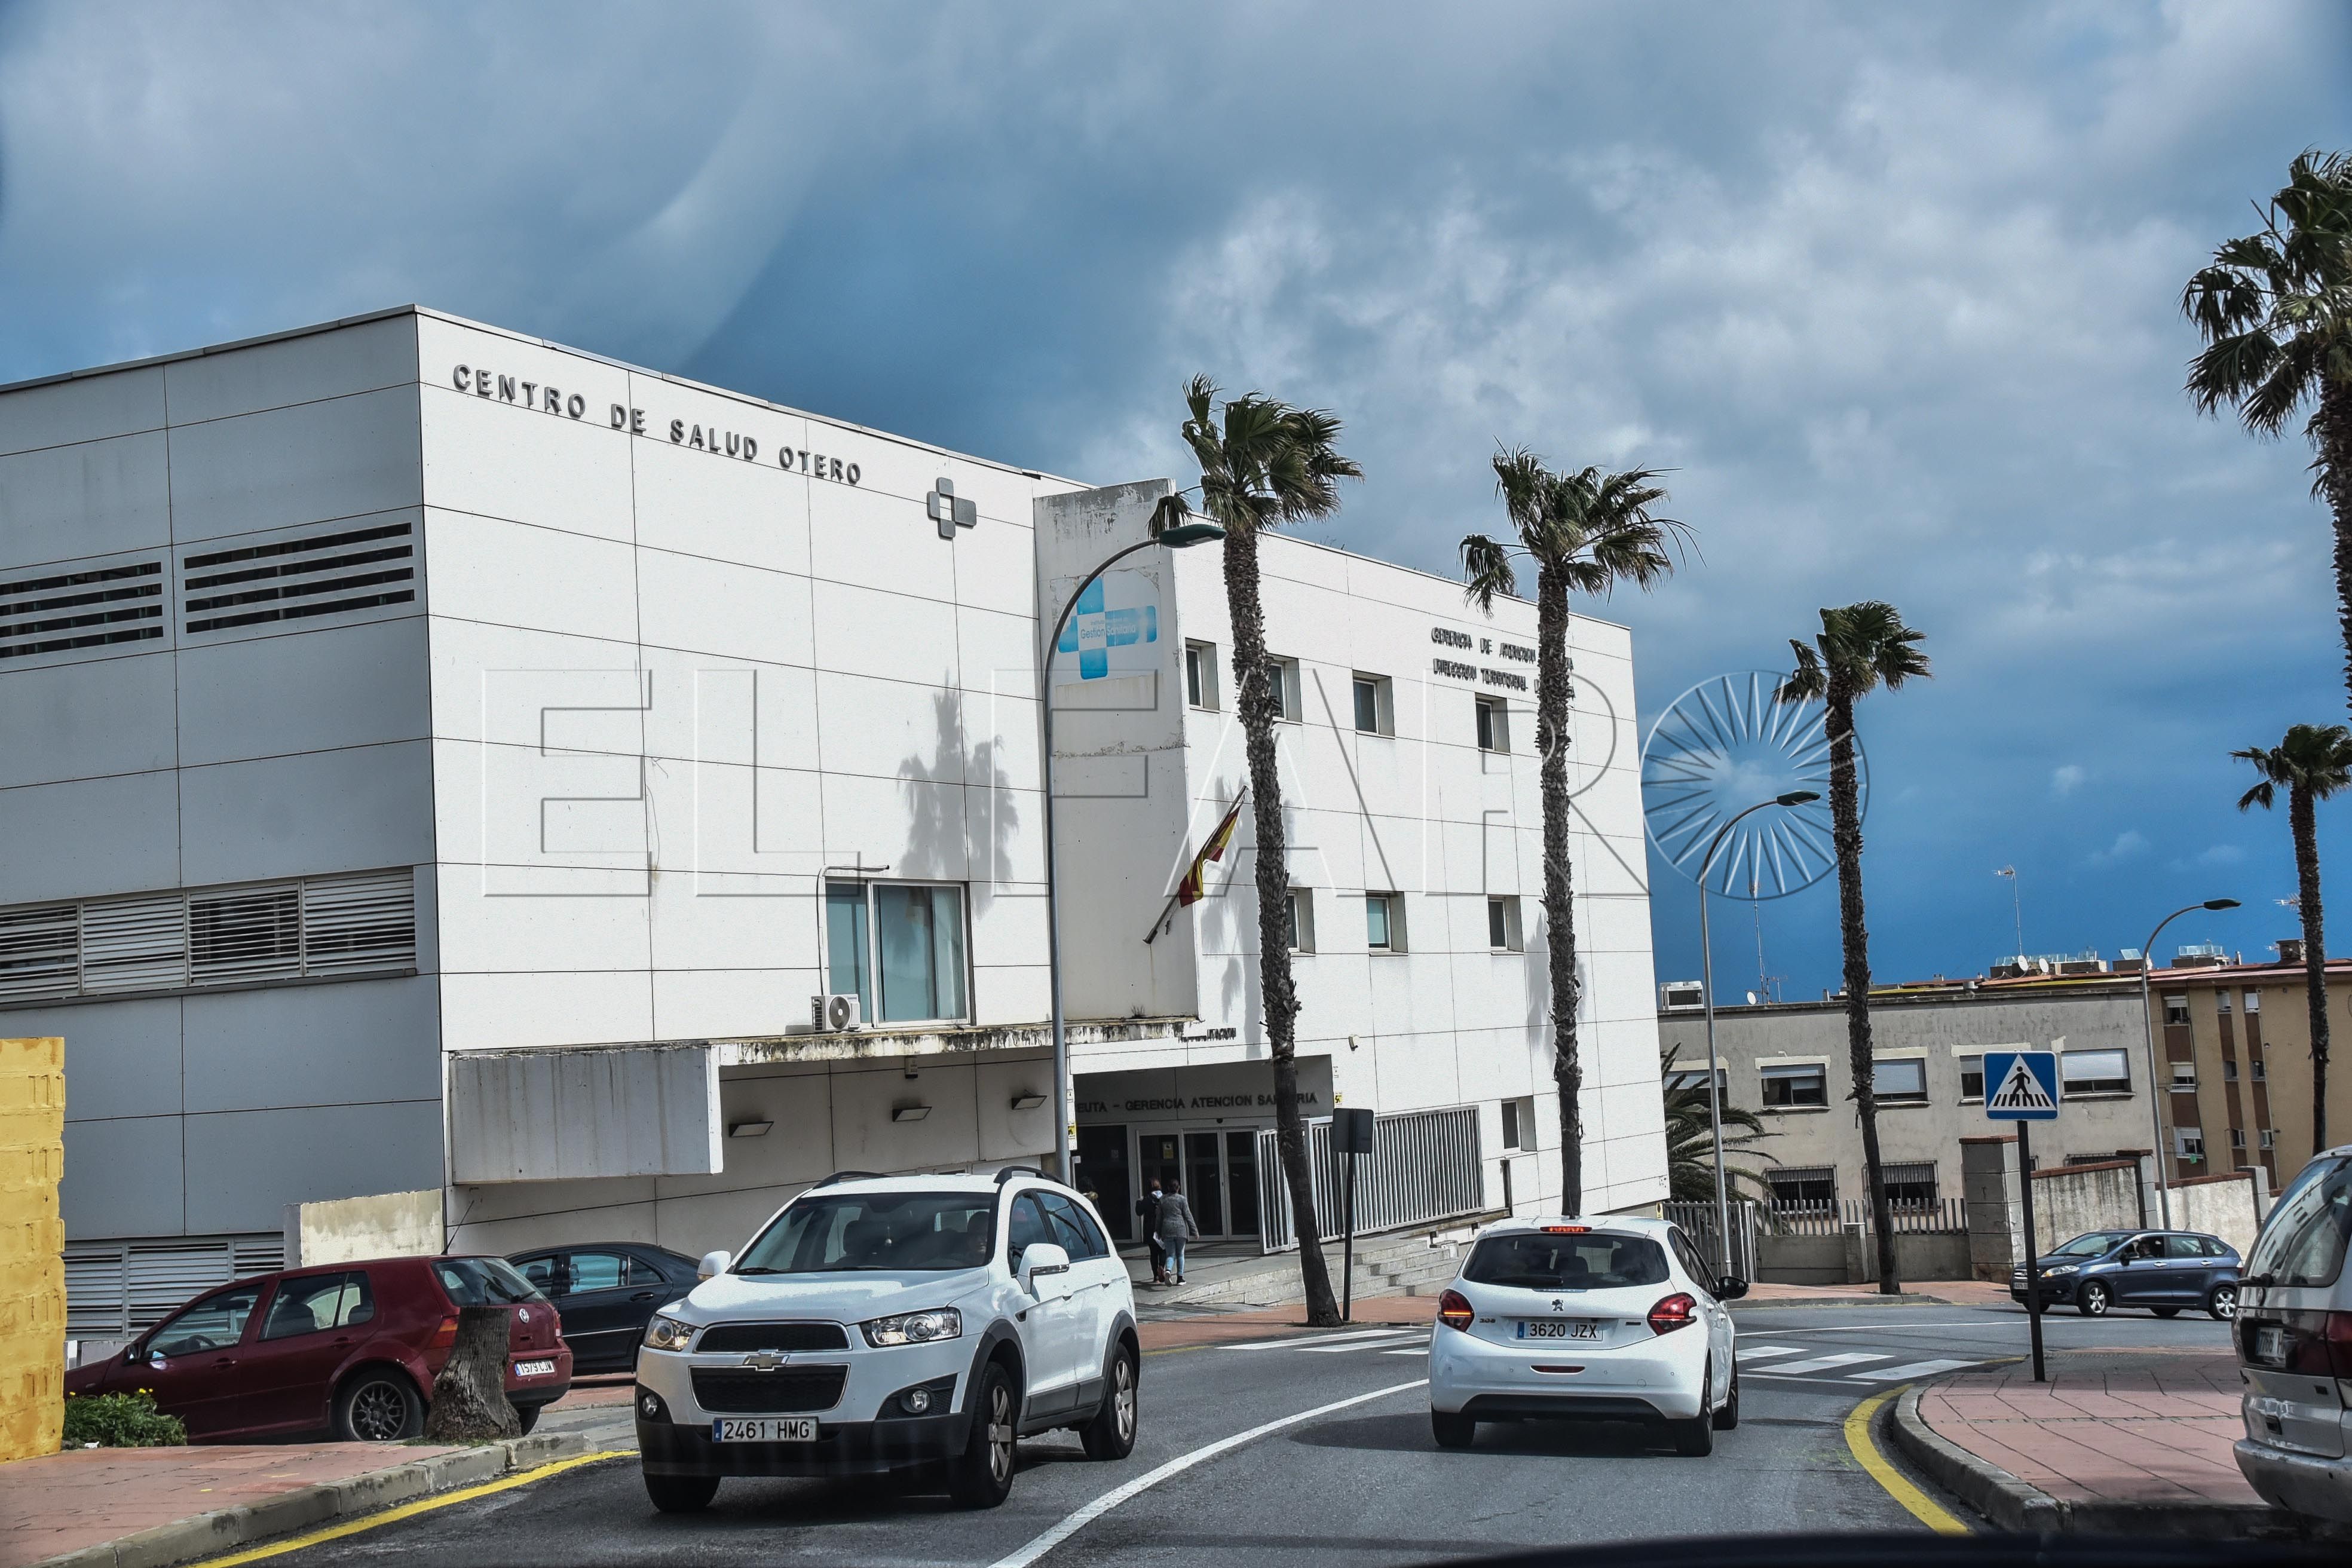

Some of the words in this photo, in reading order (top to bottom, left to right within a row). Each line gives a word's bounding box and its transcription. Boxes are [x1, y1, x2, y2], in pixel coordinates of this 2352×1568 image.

[453, 364, 586, 419] CENTRO
[611, 403, 647, 436] DE
[670, 419, 758, 461] SALUD
[779, 446, 861, 485] OTERO
[1431, 627, 1472, 651] GERENCIA
[1480, 638, 1493, 655] DE
[1499, 642, 1536, 664] ATENCION
[1433, 658, 1477, 682] DIRECCION
[1076, 1101, 1108, 1113] EUTA
[1125, 1097, 1186, 1111] GERENCIA
[1191, 1095, 1253, 1108] ATENCION
[1257, 1092, 1319, 1106] SARIA
[1529, 1323, 1566, 1337] 3620
[1570, 1324, 1598, 1339] JZX
[724, 1421, 765, 1440] 2461
[777, 1420, 810, 1439] HMG
